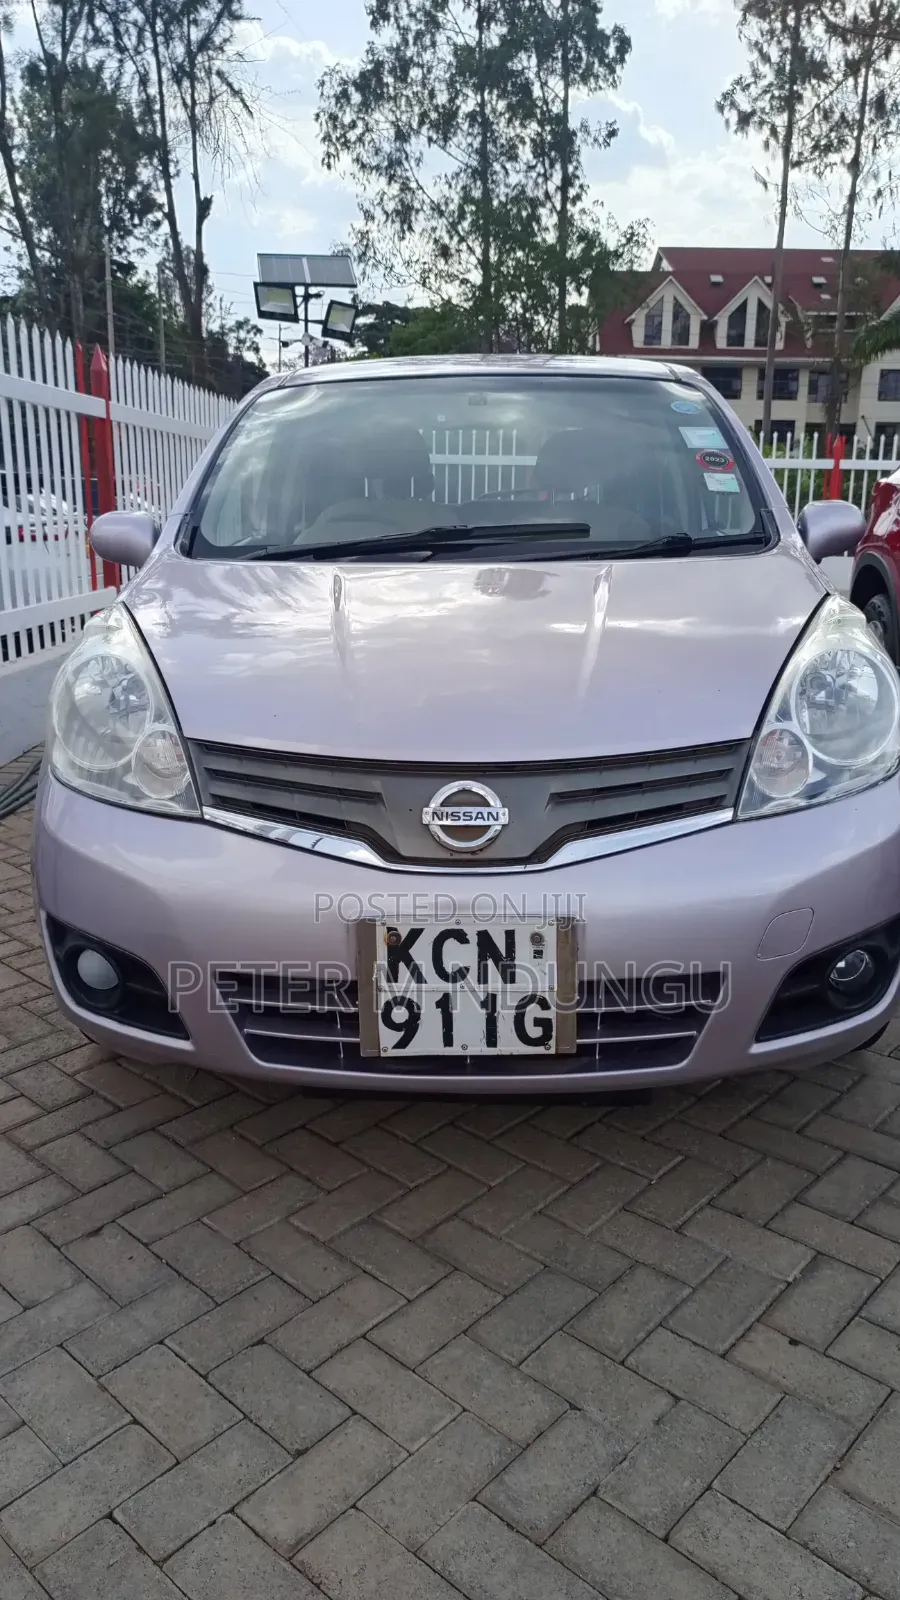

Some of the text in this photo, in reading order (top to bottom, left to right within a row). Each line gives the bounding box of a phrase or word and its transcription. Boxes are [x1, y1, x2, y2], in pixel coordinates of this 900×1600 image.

[704, 455, 725, 463] 2023
[431, 811, 499, 822] NISSAN
[385, 926, 516, 985] KCN
[380, 992, 554, 1050] 911G
